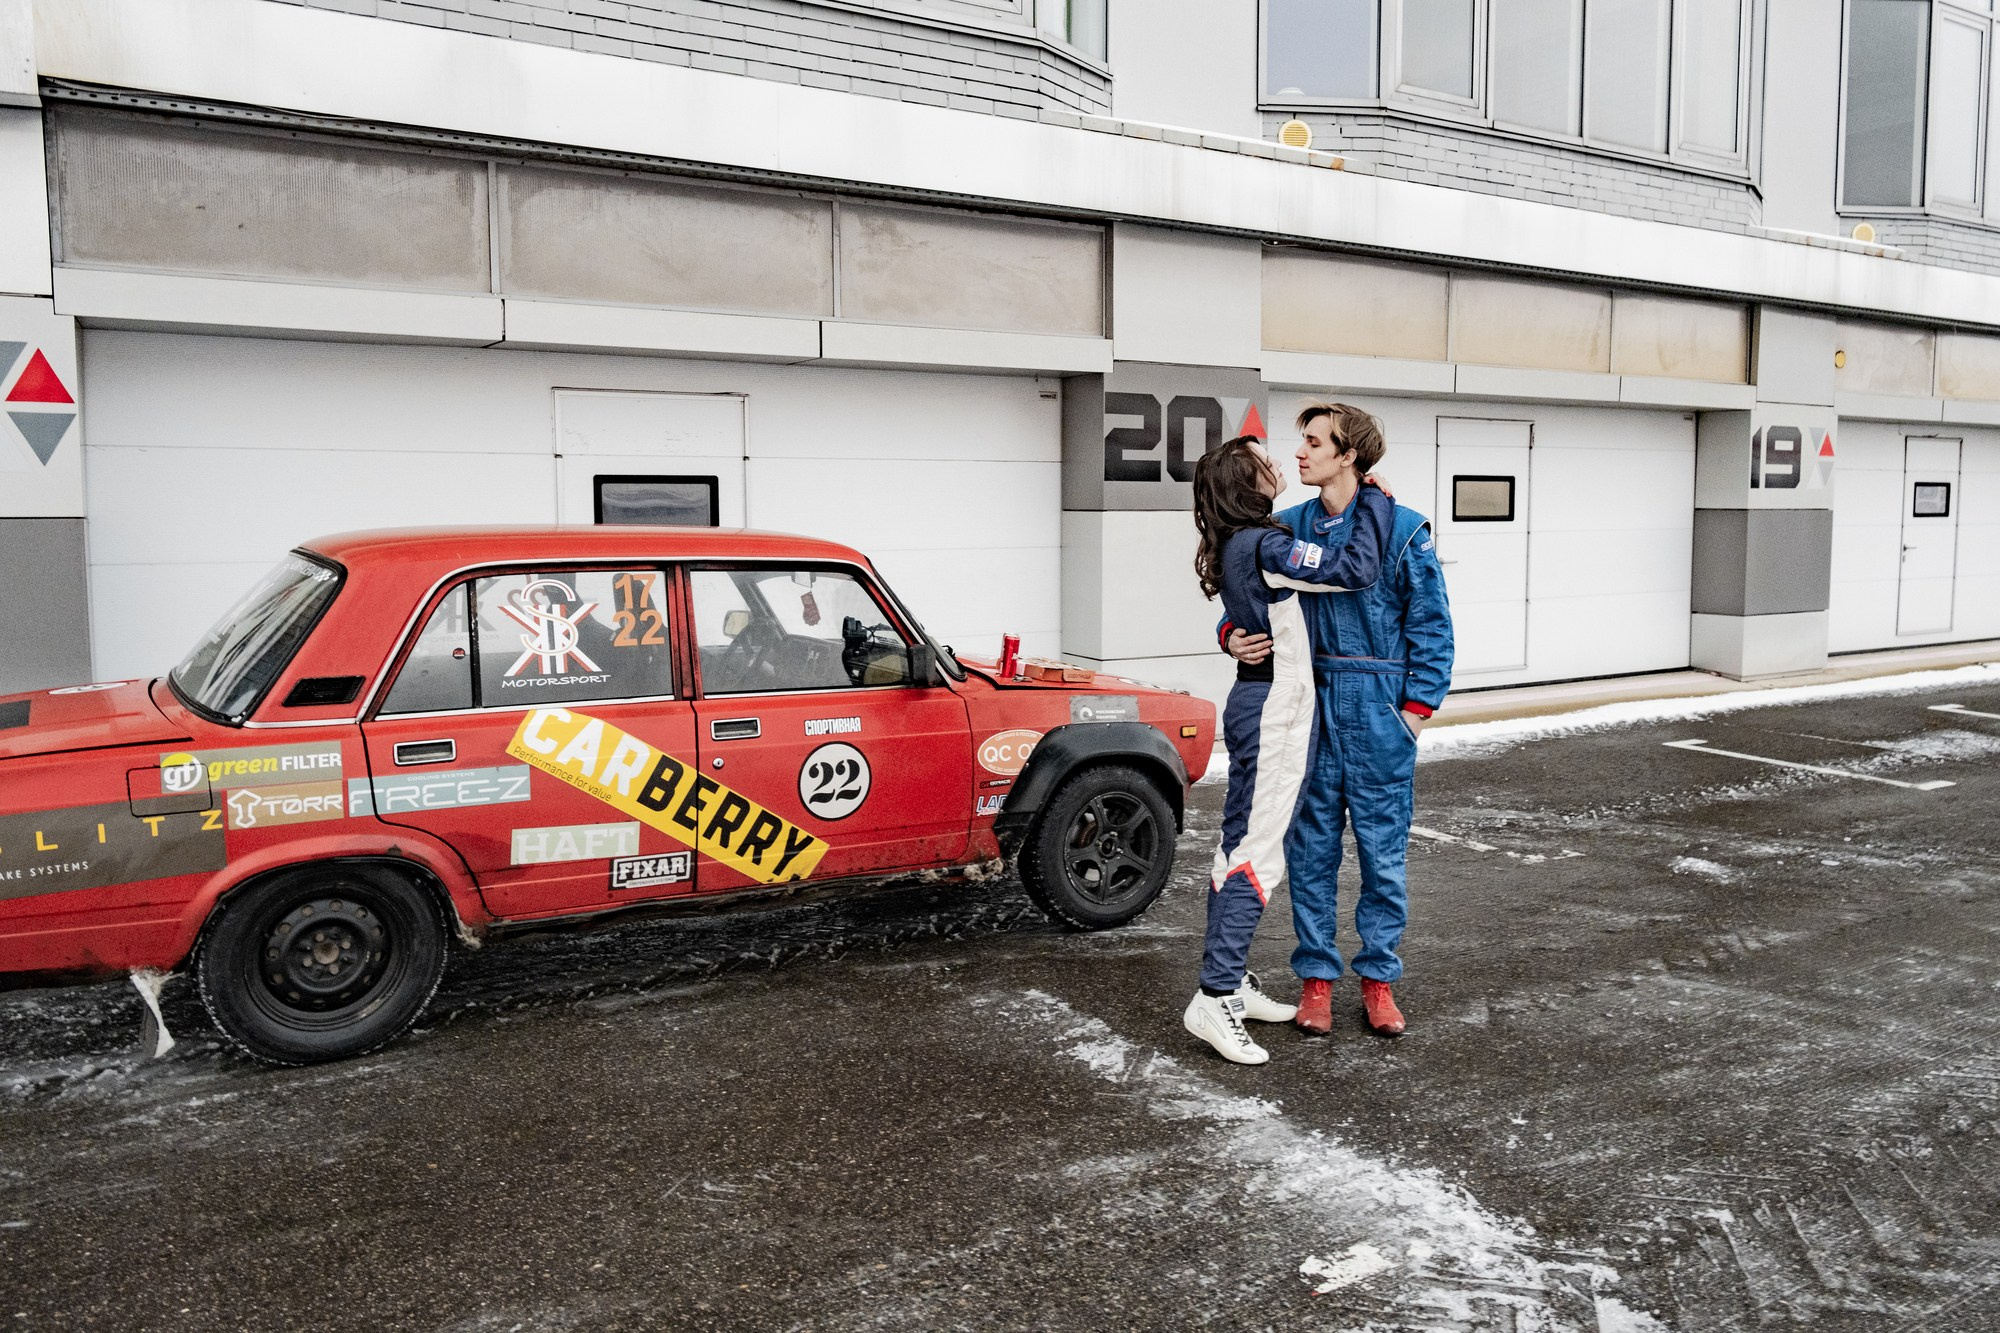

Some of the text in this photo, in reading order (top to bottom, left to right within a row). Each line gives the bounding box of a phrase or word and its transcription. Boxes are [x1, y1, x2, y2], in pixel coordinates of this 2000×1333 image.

[1104, 392, 1223, 482] 20
[1750, 425, 1802, 489] 19
[614, 573, 657, 609] 17
[612, 609, 665, 647] 22
[501, 674, 612, 689] MOTORSPORT
[804, 716, 862, 736] СПОРТИВНАЯ
[208, 753, 342, 782] green FILTER
[983, 745, 1012, 762] QC
[407, 771, 476, 782] COOLING SYSTEMS
[513, 746, 612, 801] Performance for value
[808, 759, 862, 804] 22
[521, 708, 815, 877] CARBERRY
[0, 809, 224, 855] LITZ
[515, 826, 636, 864] HAFT
[29, 860, 90, 877] SYSTEMS
[619, 857, 686, 880] FIXAR
